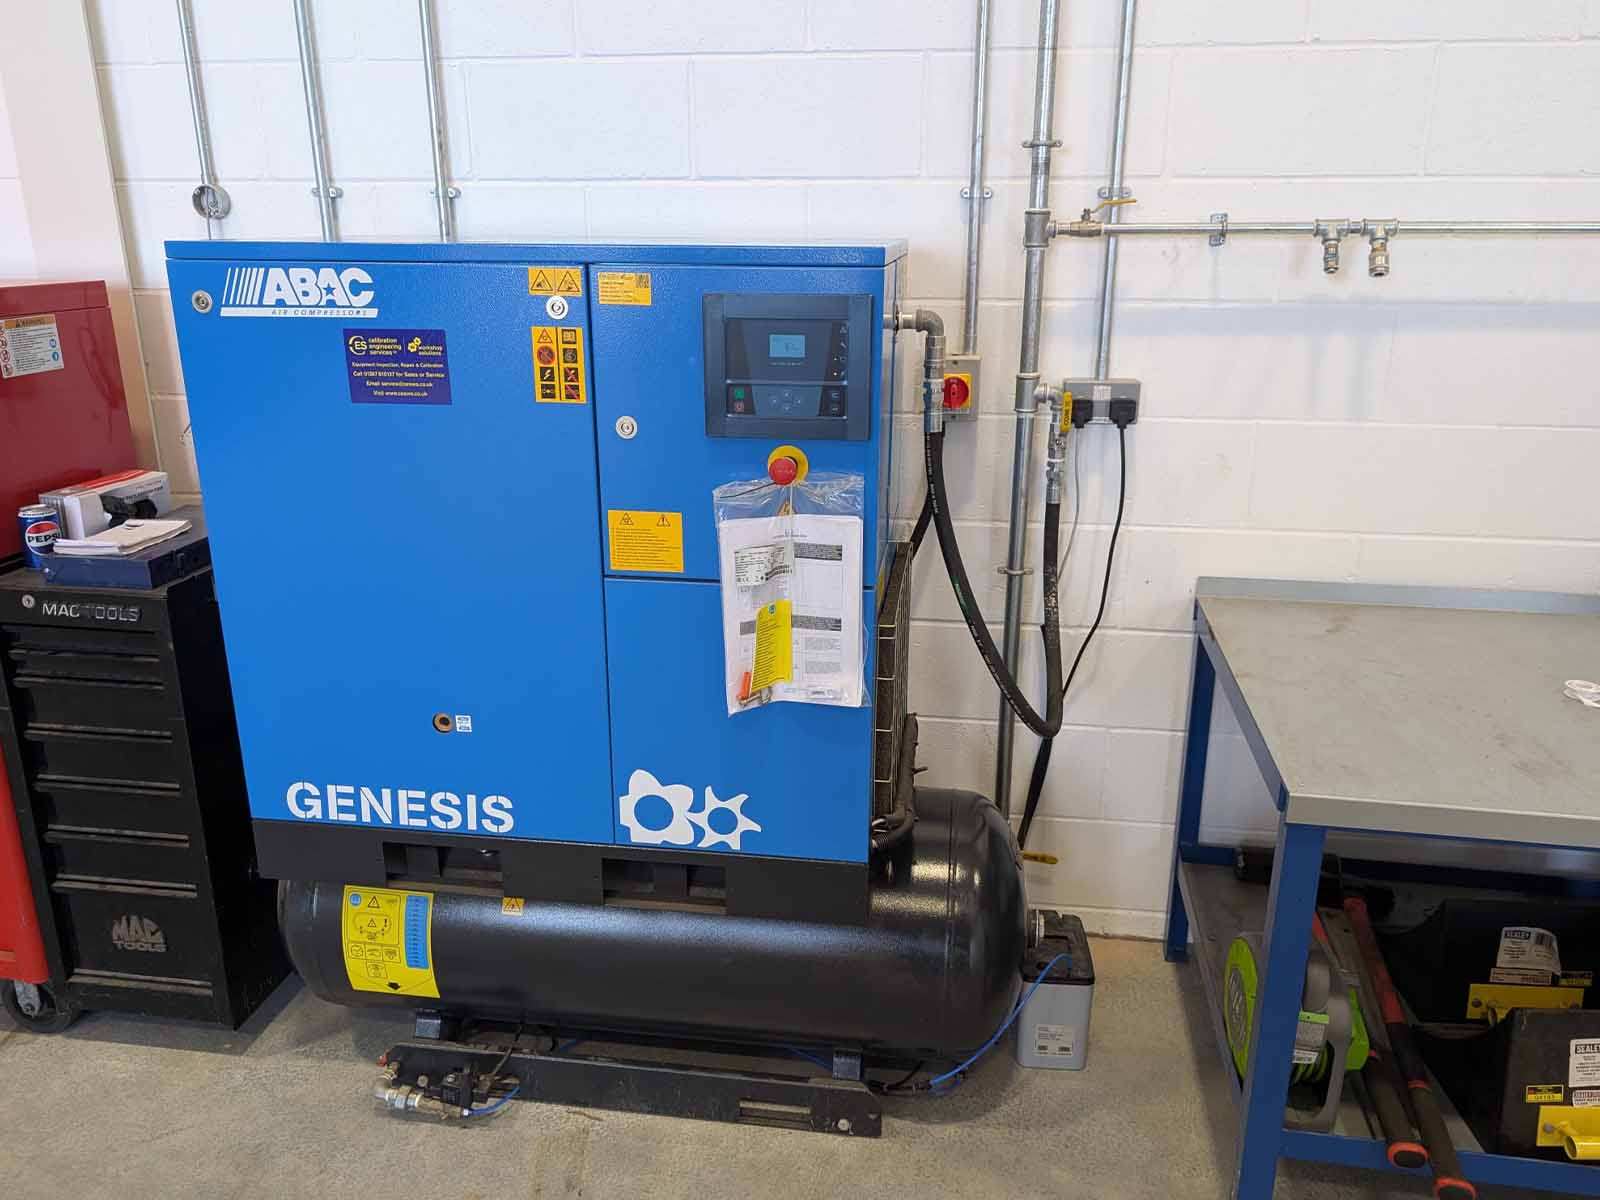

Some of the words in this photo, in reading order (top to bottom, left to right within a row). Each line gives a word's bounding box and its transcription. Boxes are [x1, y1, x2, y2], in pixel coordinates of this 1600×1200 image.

[262, 267, 375, 307] ABAC
[271, 308, 289, 316] AIR
[42, 602, 80, 618] MAC
[286, 782, 514, 833] GENESIS
[112, 915, 164, 943] MAC
[111, 940, 167, 953] TOOLS
